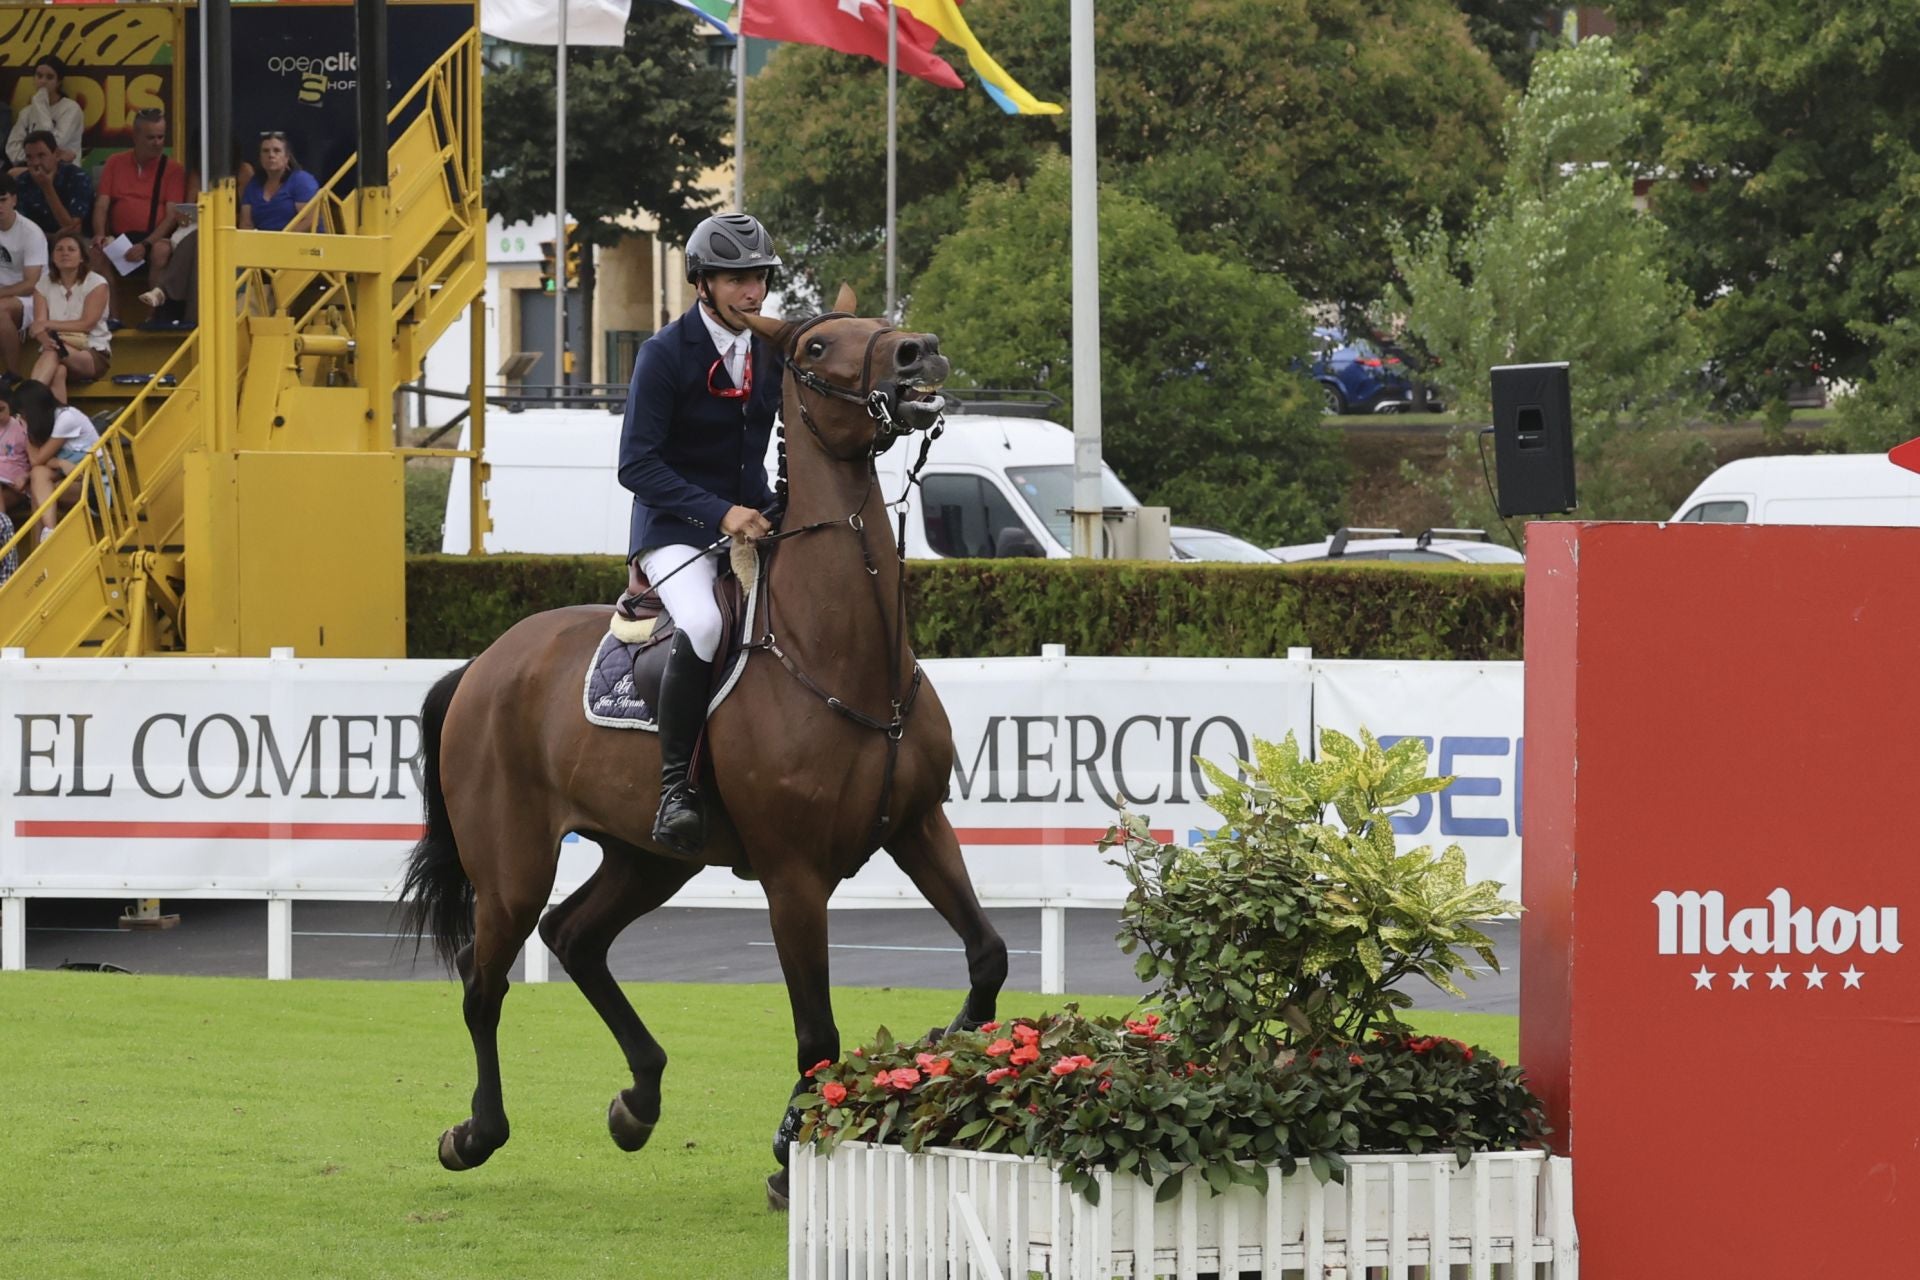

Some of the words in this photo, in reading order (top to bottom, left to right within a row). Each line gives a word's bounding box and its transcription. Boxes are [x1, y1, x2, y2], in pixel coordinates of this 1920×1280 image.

[13, 713, 114, 797] EL
[131, 712, 426, 799] COMER
[943, 715, 1251, 810] MERCIO
[1651, 887, 1904, 955] Mahou
